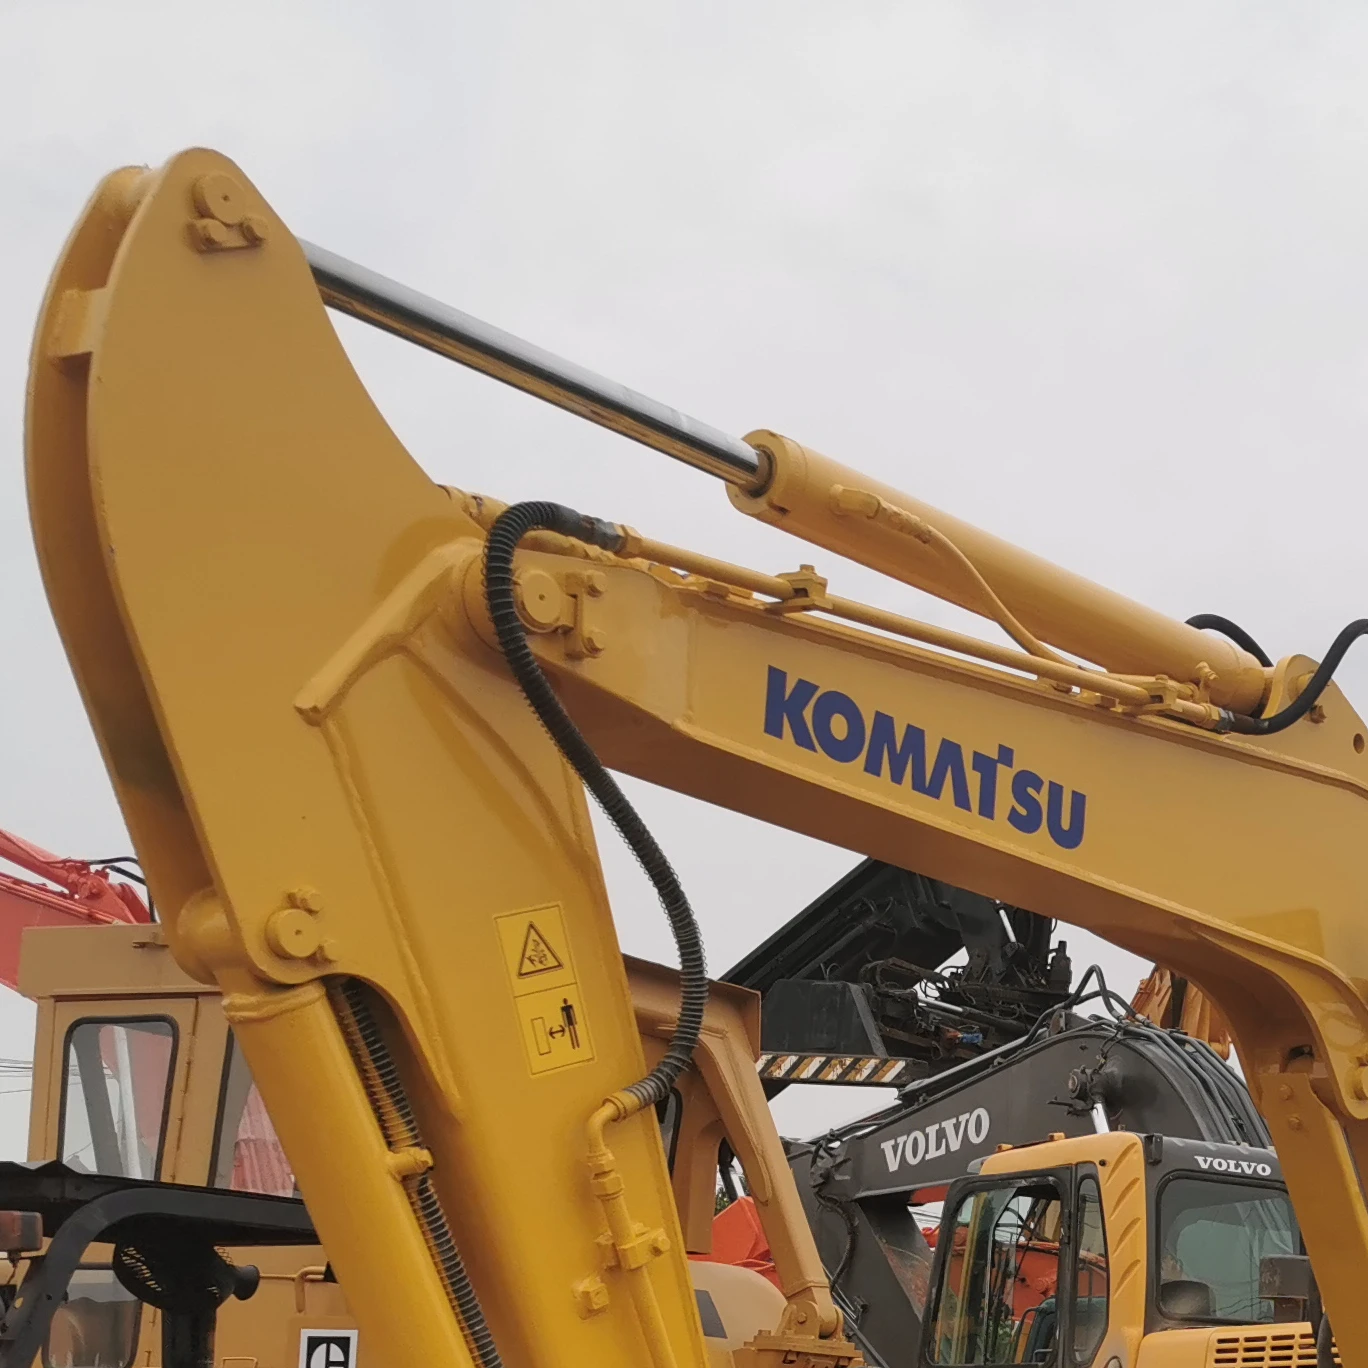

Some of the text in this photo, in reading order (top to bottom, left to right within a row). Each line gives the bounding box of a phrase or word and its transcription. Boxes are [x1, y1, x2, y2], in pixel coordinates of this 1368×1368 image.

[763, 664, 1087, 850] KOMATSU
[880, 1107, 990, 1173] VOLVO
[1194, 1155, 1272, 1176] VOLVO
